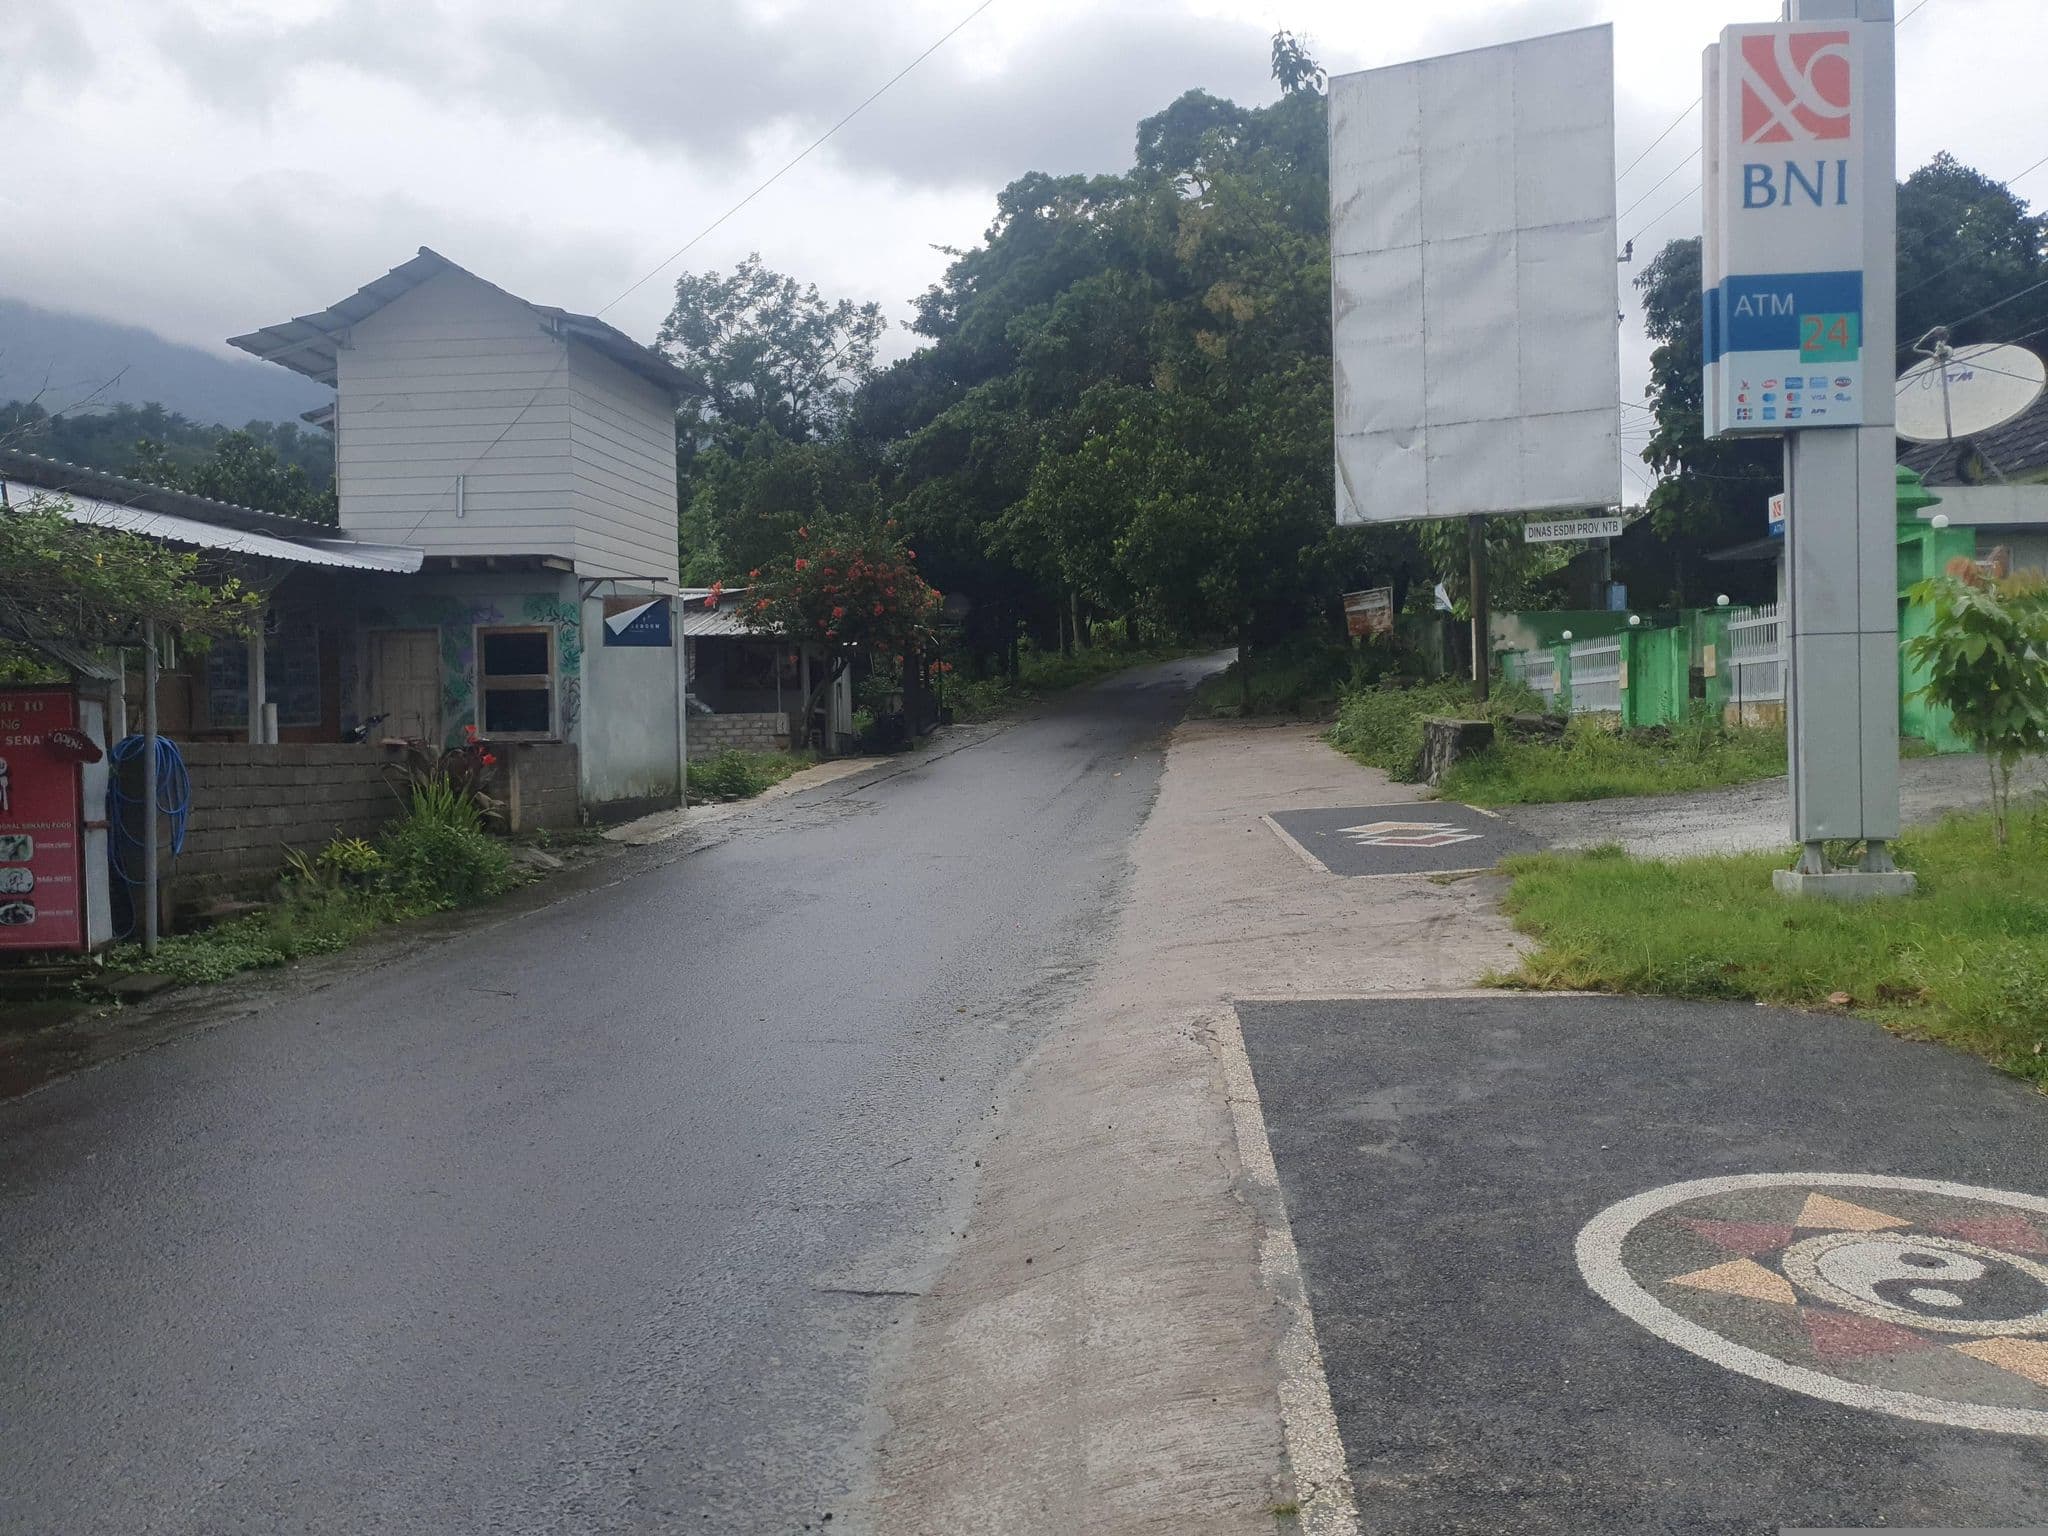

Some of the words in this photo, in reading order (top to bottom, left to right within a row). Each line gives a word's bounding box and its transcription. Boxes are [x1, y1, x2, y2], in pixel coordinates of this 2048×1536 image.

[1743, 159, 1849, 209] BNI
[1734, 293, 1794, 317] ATM
[1803, 315, 1849, 352] 24
[1528, 525, 1552, 538] DINAS
[1553, 524, 1576, 536] ESDM
[1577, 522, 1600, 535] PROV.
[1602, 520, 1619, 532] NTB
